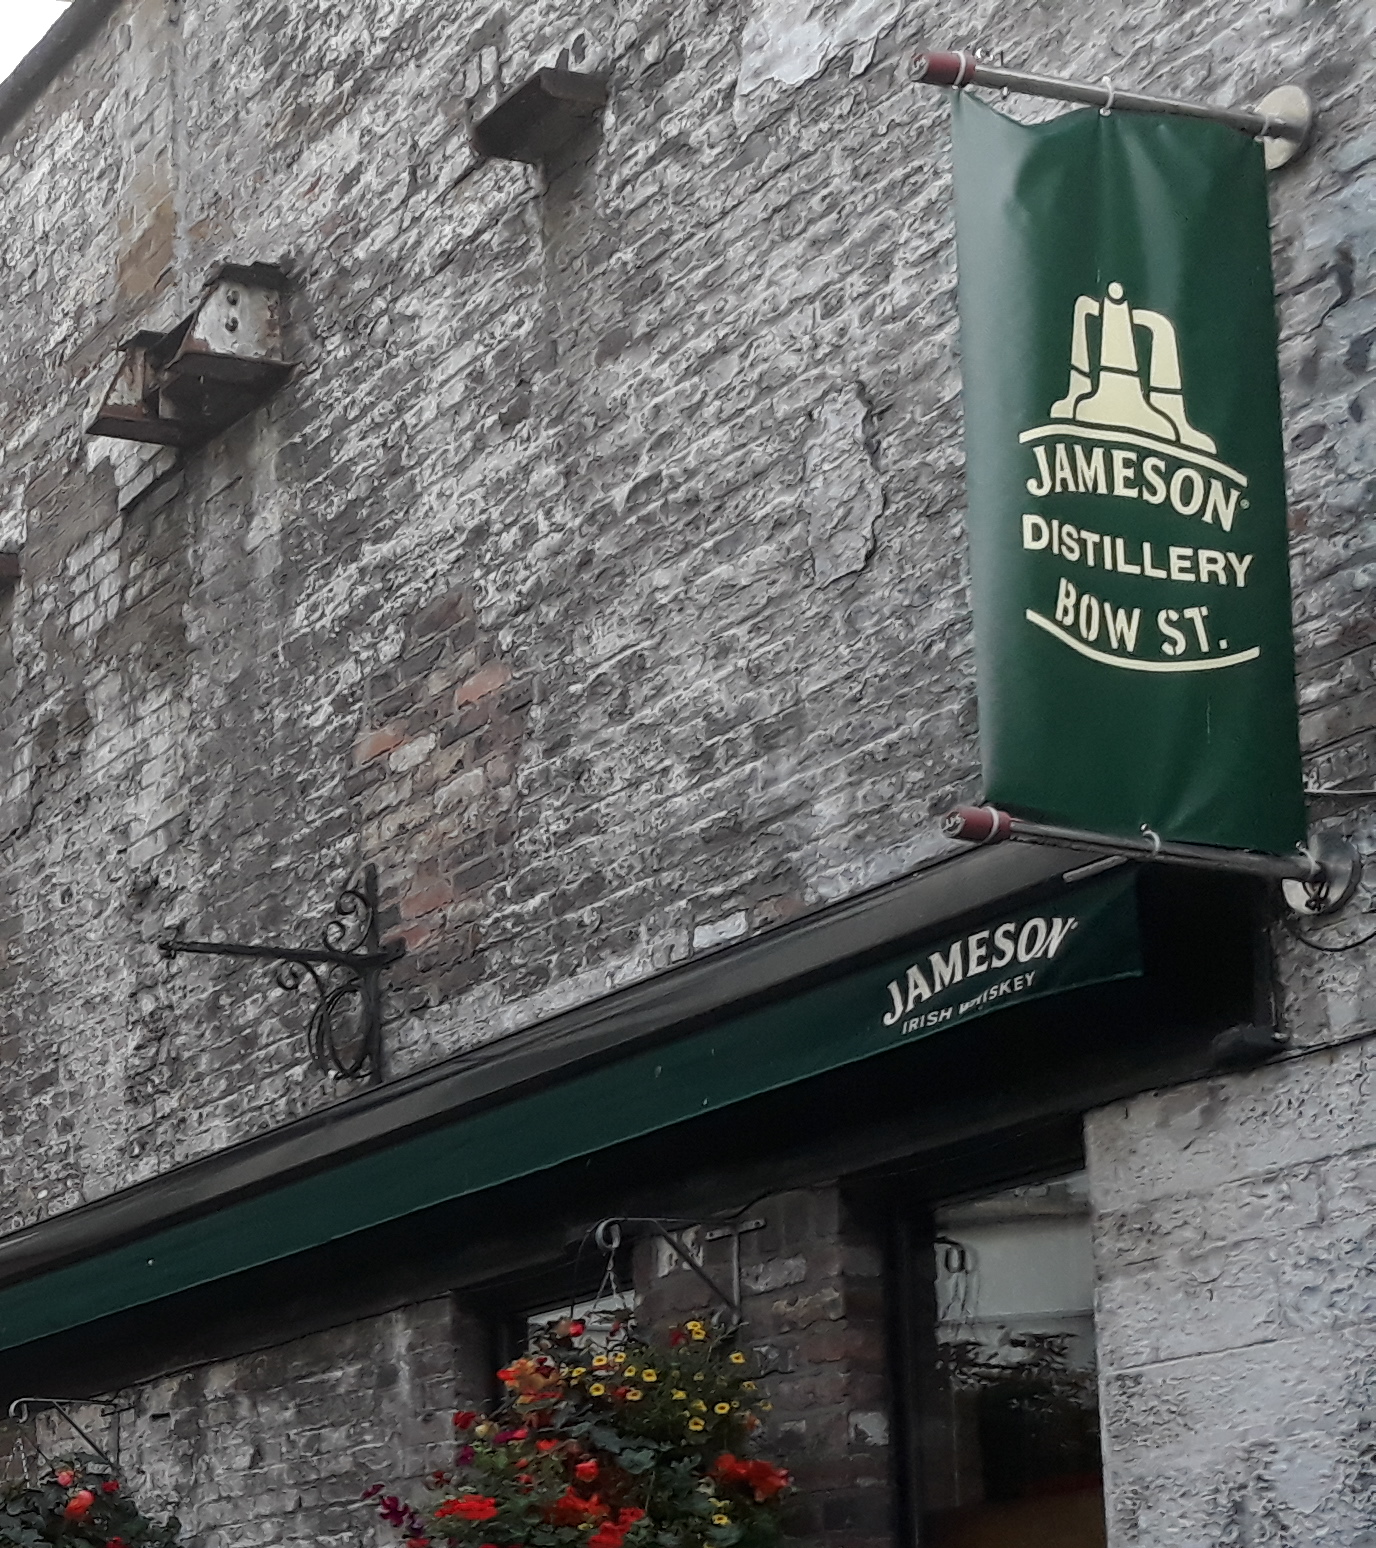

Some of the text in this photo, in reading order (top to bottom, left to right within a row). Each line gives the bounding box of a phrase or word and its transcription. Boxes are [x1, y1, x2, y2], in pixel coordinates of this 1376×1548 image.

[1026, 442, 1242, 533] JAMESON
[1022, 513, 1254, 588] DISTILLERY
[1055, 577, 1229, 656] BOW ST.
[883, 916, 1076, 1027] JAMESON
[901, 970, 1036, 1035] IRISH WHISKEY
